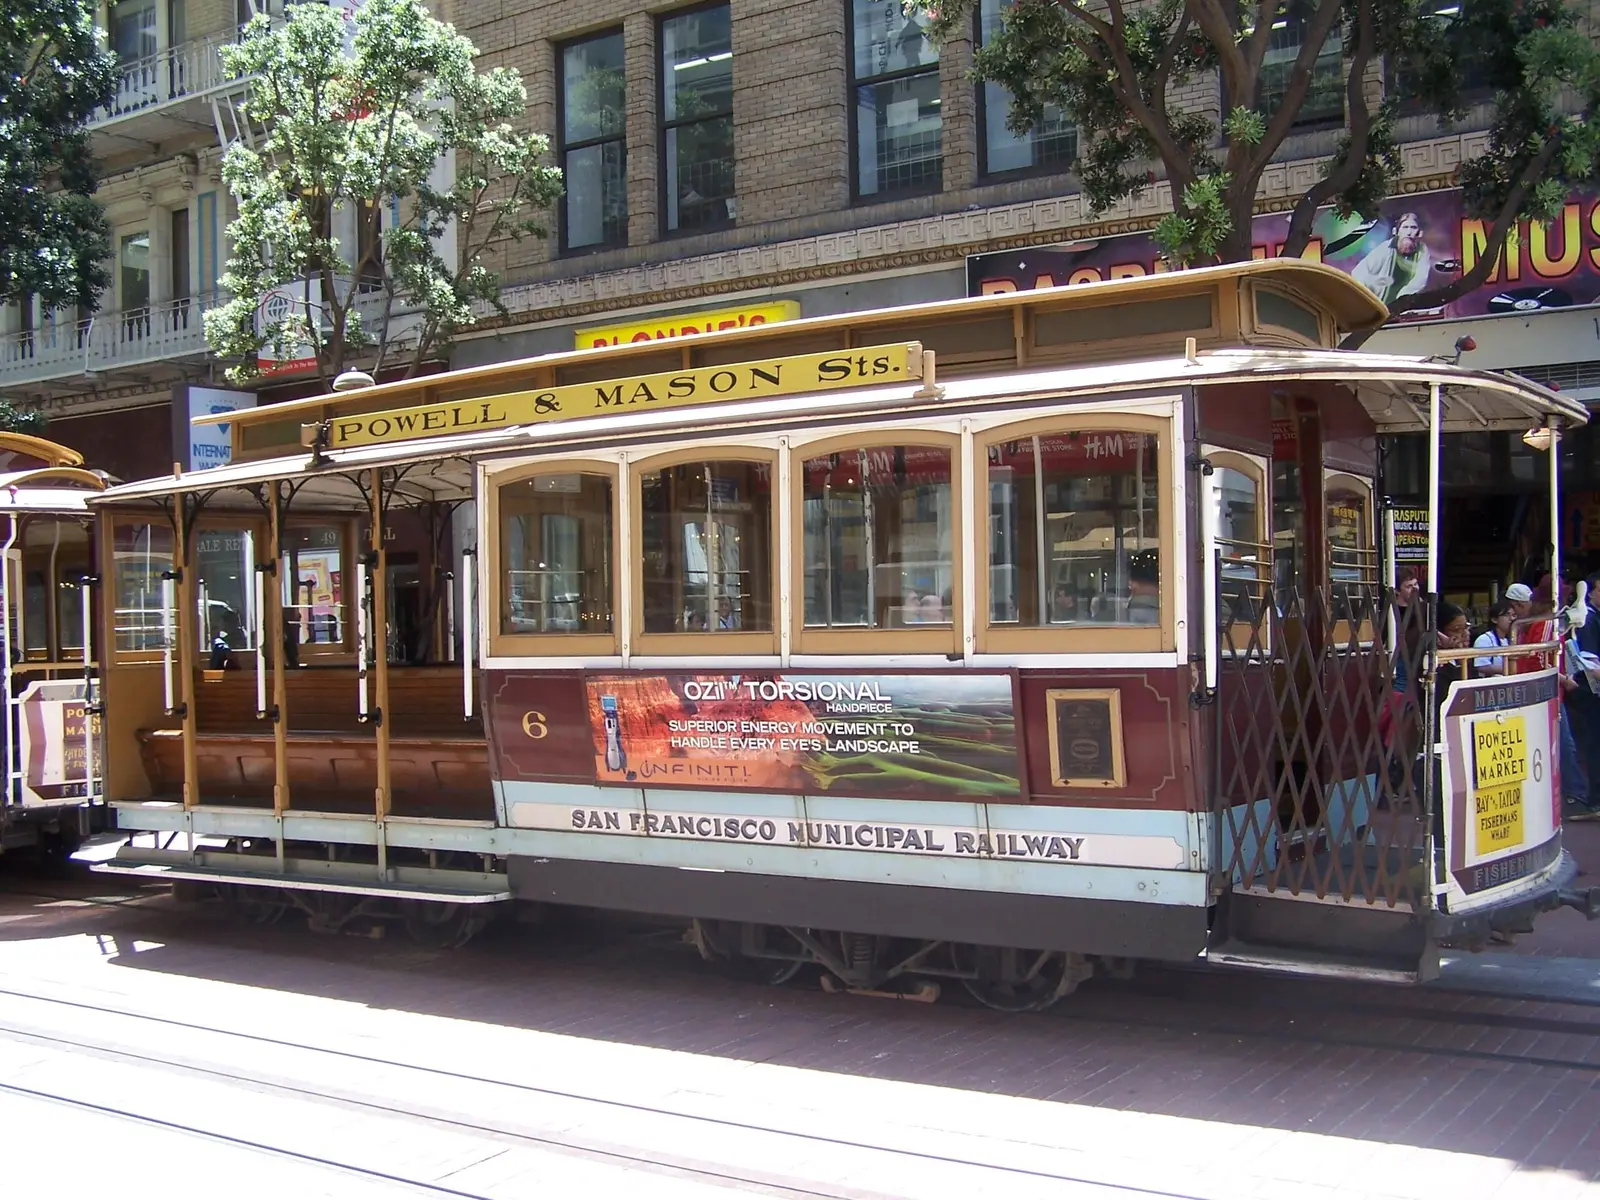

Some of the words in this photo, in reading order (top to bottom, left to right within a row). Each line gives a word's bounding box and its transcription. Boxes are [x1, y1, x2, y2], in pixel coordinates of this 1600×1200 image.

[1461, 196, 1600, 285] MU
[338, 403, 507, 442] POWELL
[534, 393, 563, 415] &
[594, 364, 783, 408] MASON
[817, 354, 900, 383] Sts.
[1083, 434, 1123, 459] H&M
[1394, 510, 1430, 521] RASPUTI
[1394, 522, 1412, 531] MUSIC
[1413, 522, 1419, 531] &
[197, 539, 221, 553] ALE
[322, 532, 336, 544] 49
[1394, 534, 1430, 546] UPERSTOR
[743, 681, 892, 702] TORSIONAL
[1474, 685, 1529, 710] MARKET
[826, 702, 893, 713] HANDPIECE
[522, 710, 549, 739] 6
[668, 719, 737, 733] SUPERIOR
[740, 720, 798, 734] ENERGY
[801, 721, 888, 735] MOVEMENT
[889, 723, 915, 736] TO
[670, 737, 730, 750] HANDLE
[730, 737, 776, 751] EVERY
[779, 738, 822, 752] EYE'S
[825, 740, 920, 754] LANDSCAPE
[1478, 729, 1523, 750] POWELL
[1491, 747, 1513, 762] AND
[1479, 758, 1525, 781] MARKET
[1532, 748, 1543, 783] 6
[1475, 794, 1490, 814] BAY
[1498, 788, 1521, 810] TAYLOR
[1480, 810, 1518, 831] FISHERMANS
[571, 808, 621, 831] SAN
[629, 813, 777, 841] FRANCISCO
[787, 821, 945, 852] MUNICIPAL
[954, 831, 1087, 860] RAILWAY
[1490, 826, 1511, 841] WHARF
